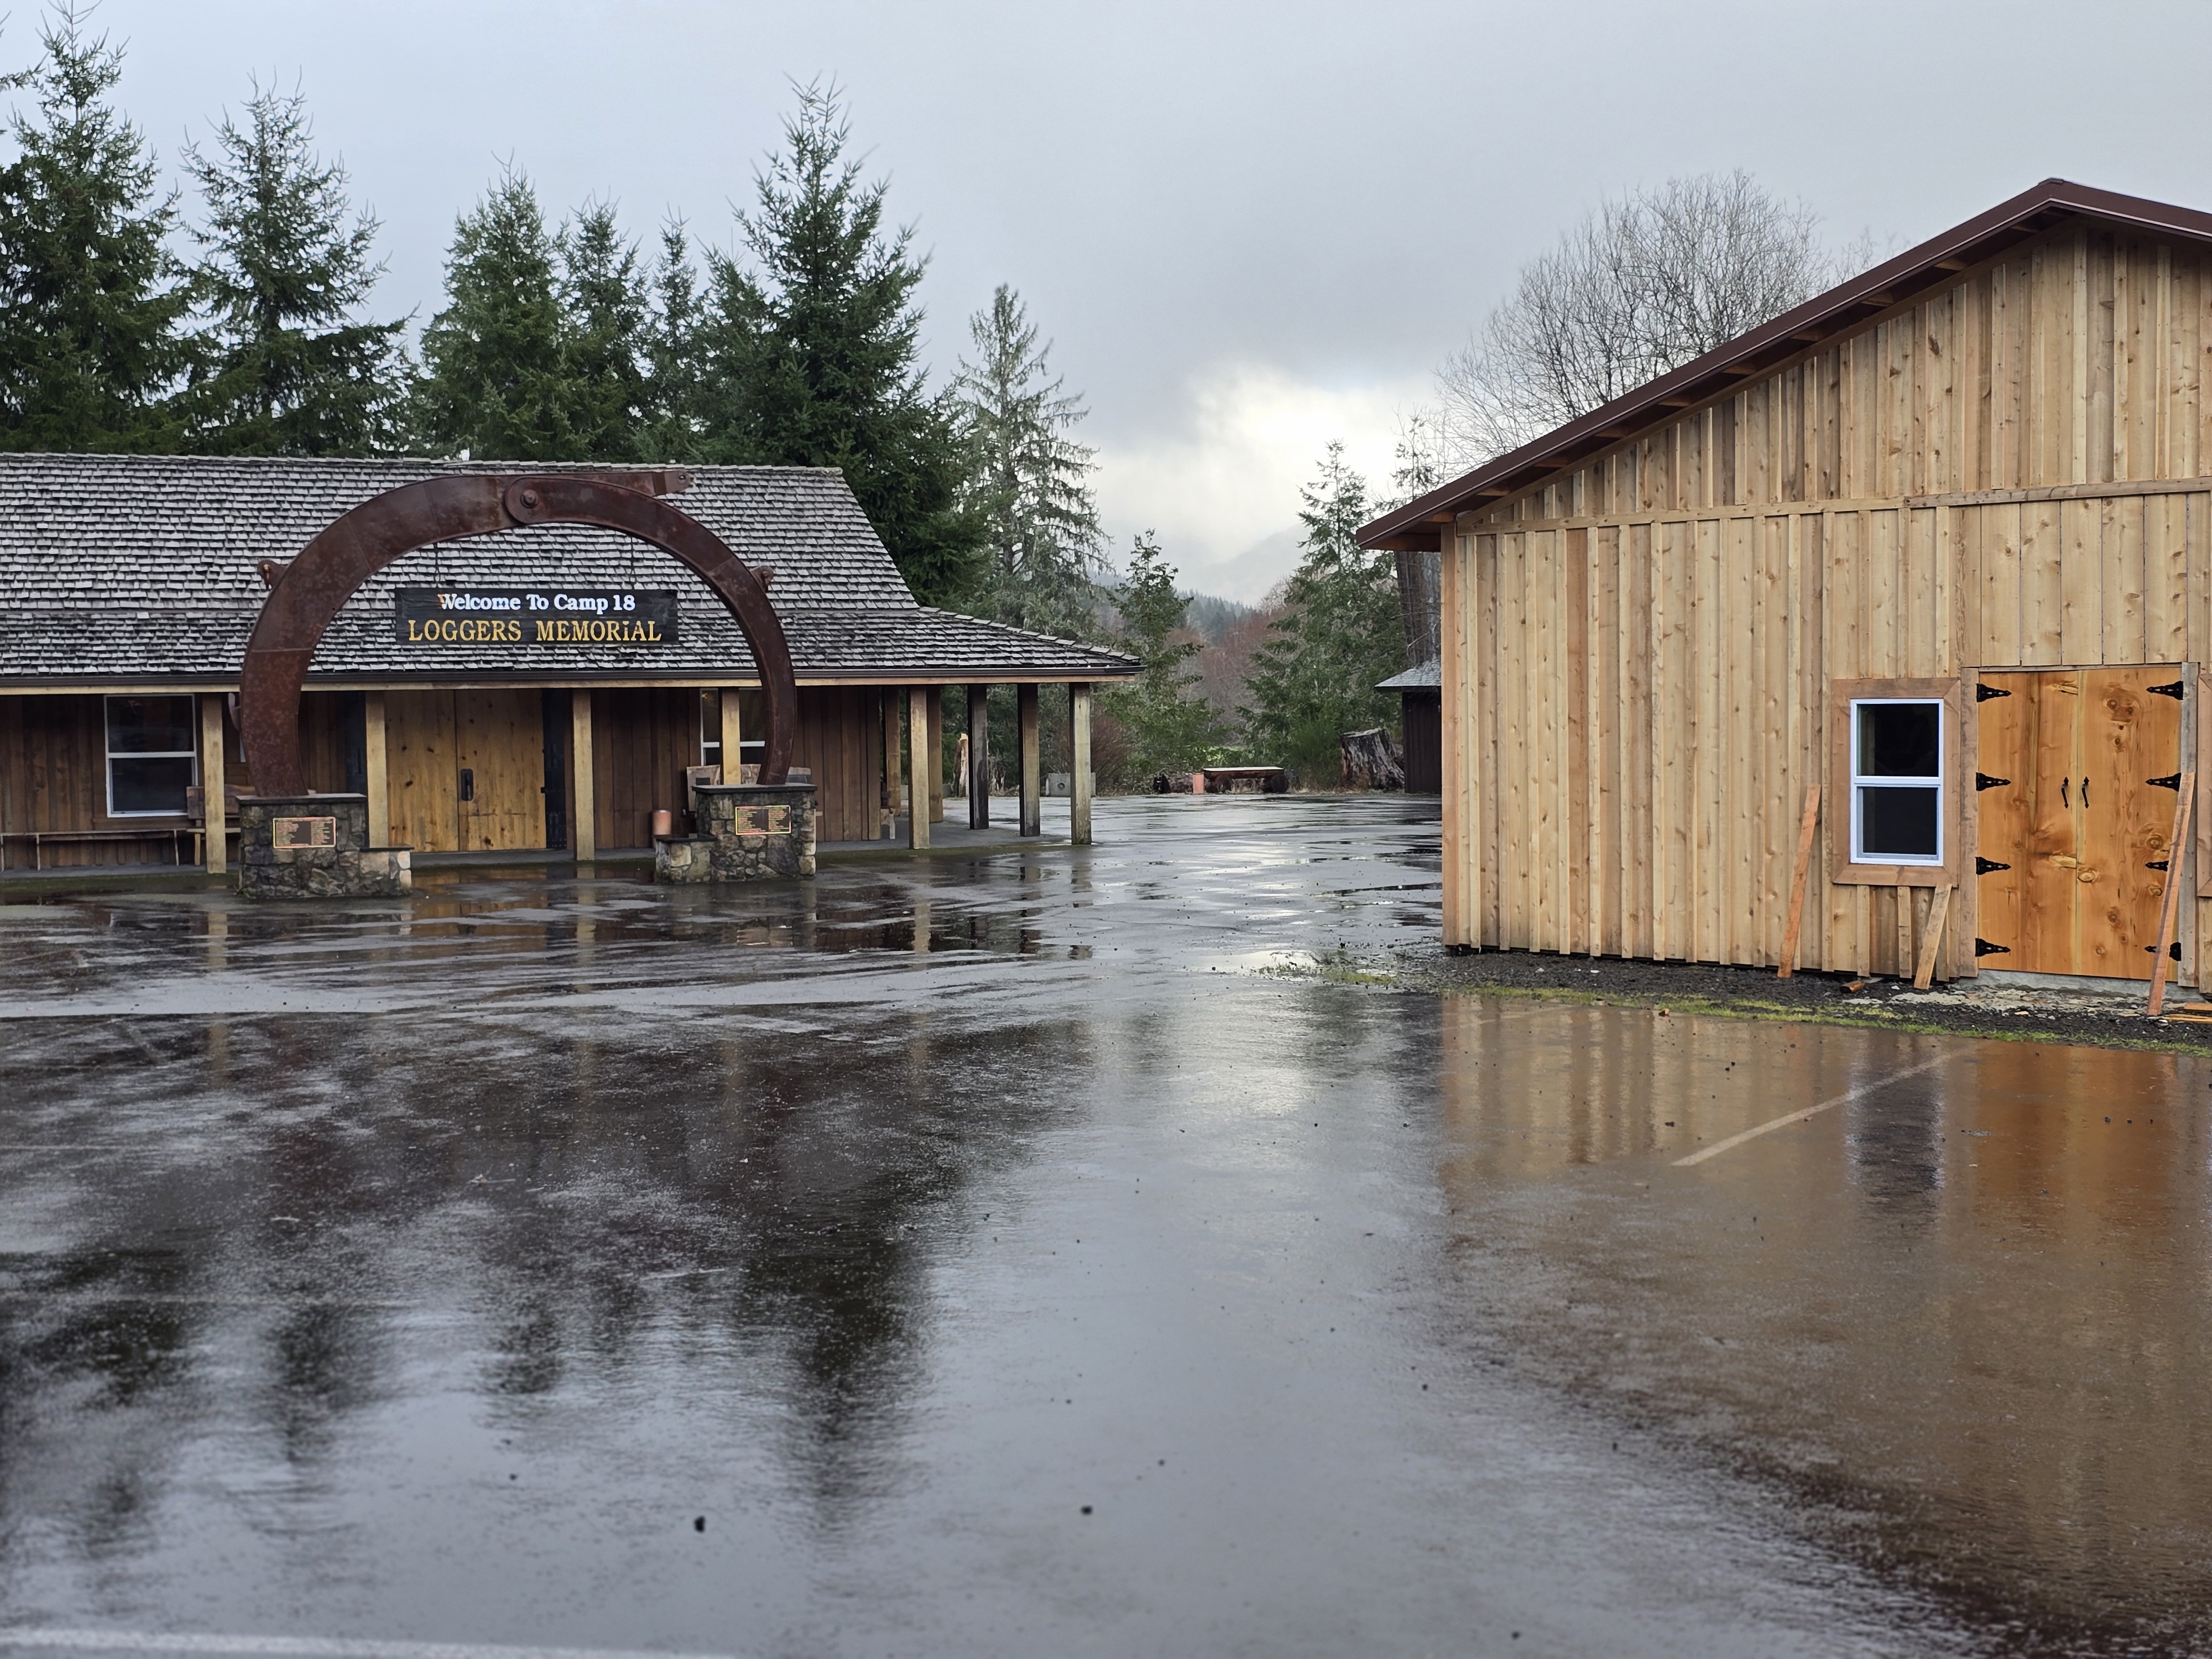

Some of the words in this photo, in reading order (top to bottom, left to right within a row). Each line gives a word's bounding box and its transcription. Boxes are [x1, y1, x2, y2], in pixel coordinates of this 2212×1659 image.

[438, 594, 521, 610] Welcome
[526, 593, 549, 610] To
[554, 593, 608, 614] Camp
[613, 594, 635, 611] 18
[409, 620, 521, 641] LOGGERS
[536, 620, 662, 641] MEMORIAL
